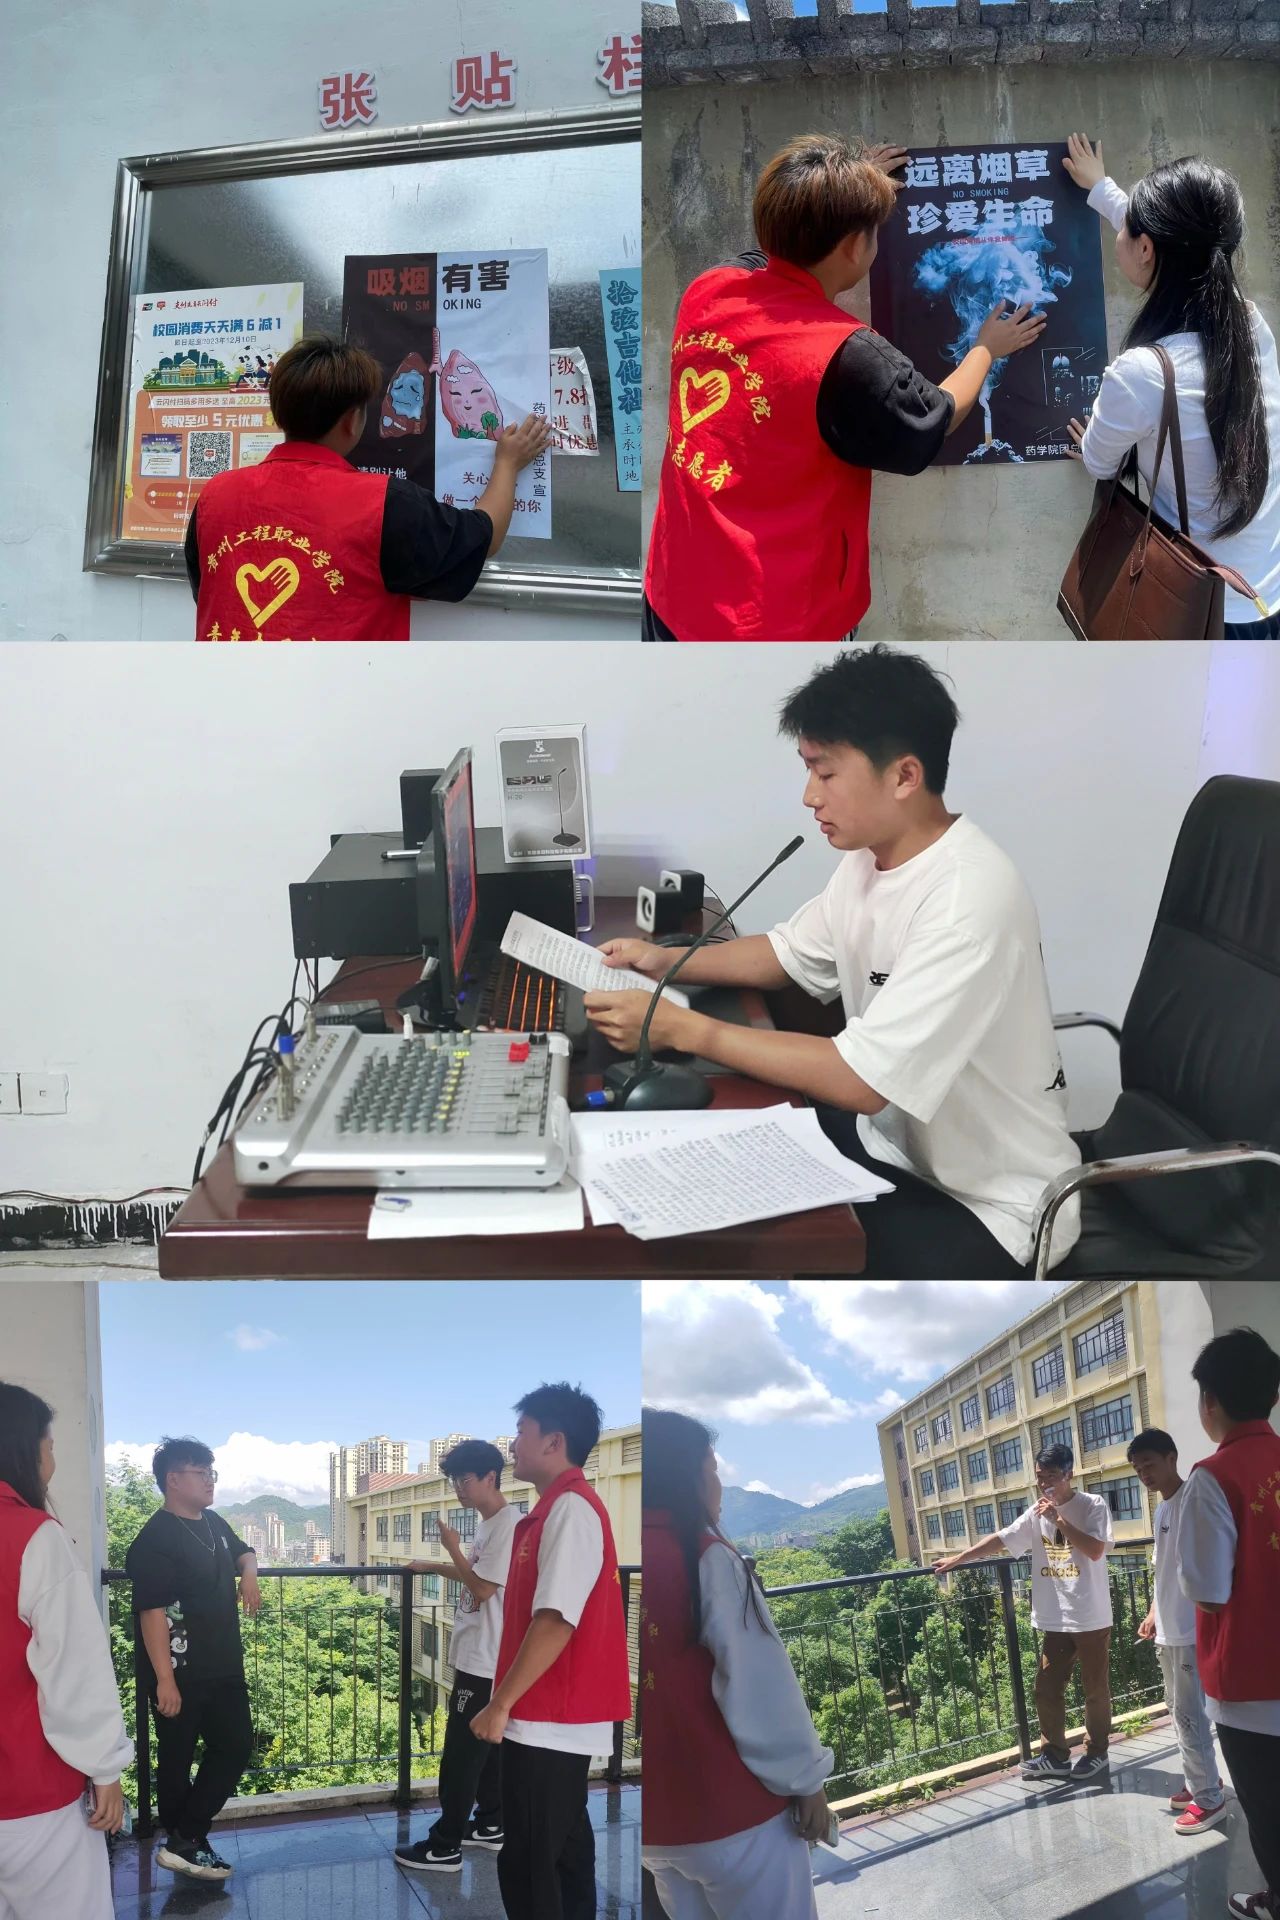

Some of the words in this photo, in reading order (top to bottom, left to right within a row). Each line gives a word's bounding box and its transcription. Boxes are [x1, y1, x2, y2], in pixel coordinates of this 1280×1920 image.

[905, 150, 1050, 188] 远离烟草
[953, 190, 964, 198] NO
[970, 188, 1009, 197] SMOKING
[907, 196, 1054, 234] 珍爱生命
[393, 301, 408, 311] NO
[607, 280, 641, 415] 拾弦吉他社
[672, 331, 771, 424] 州工程职业学院
[667, 425, 733, 491] 志愿者
